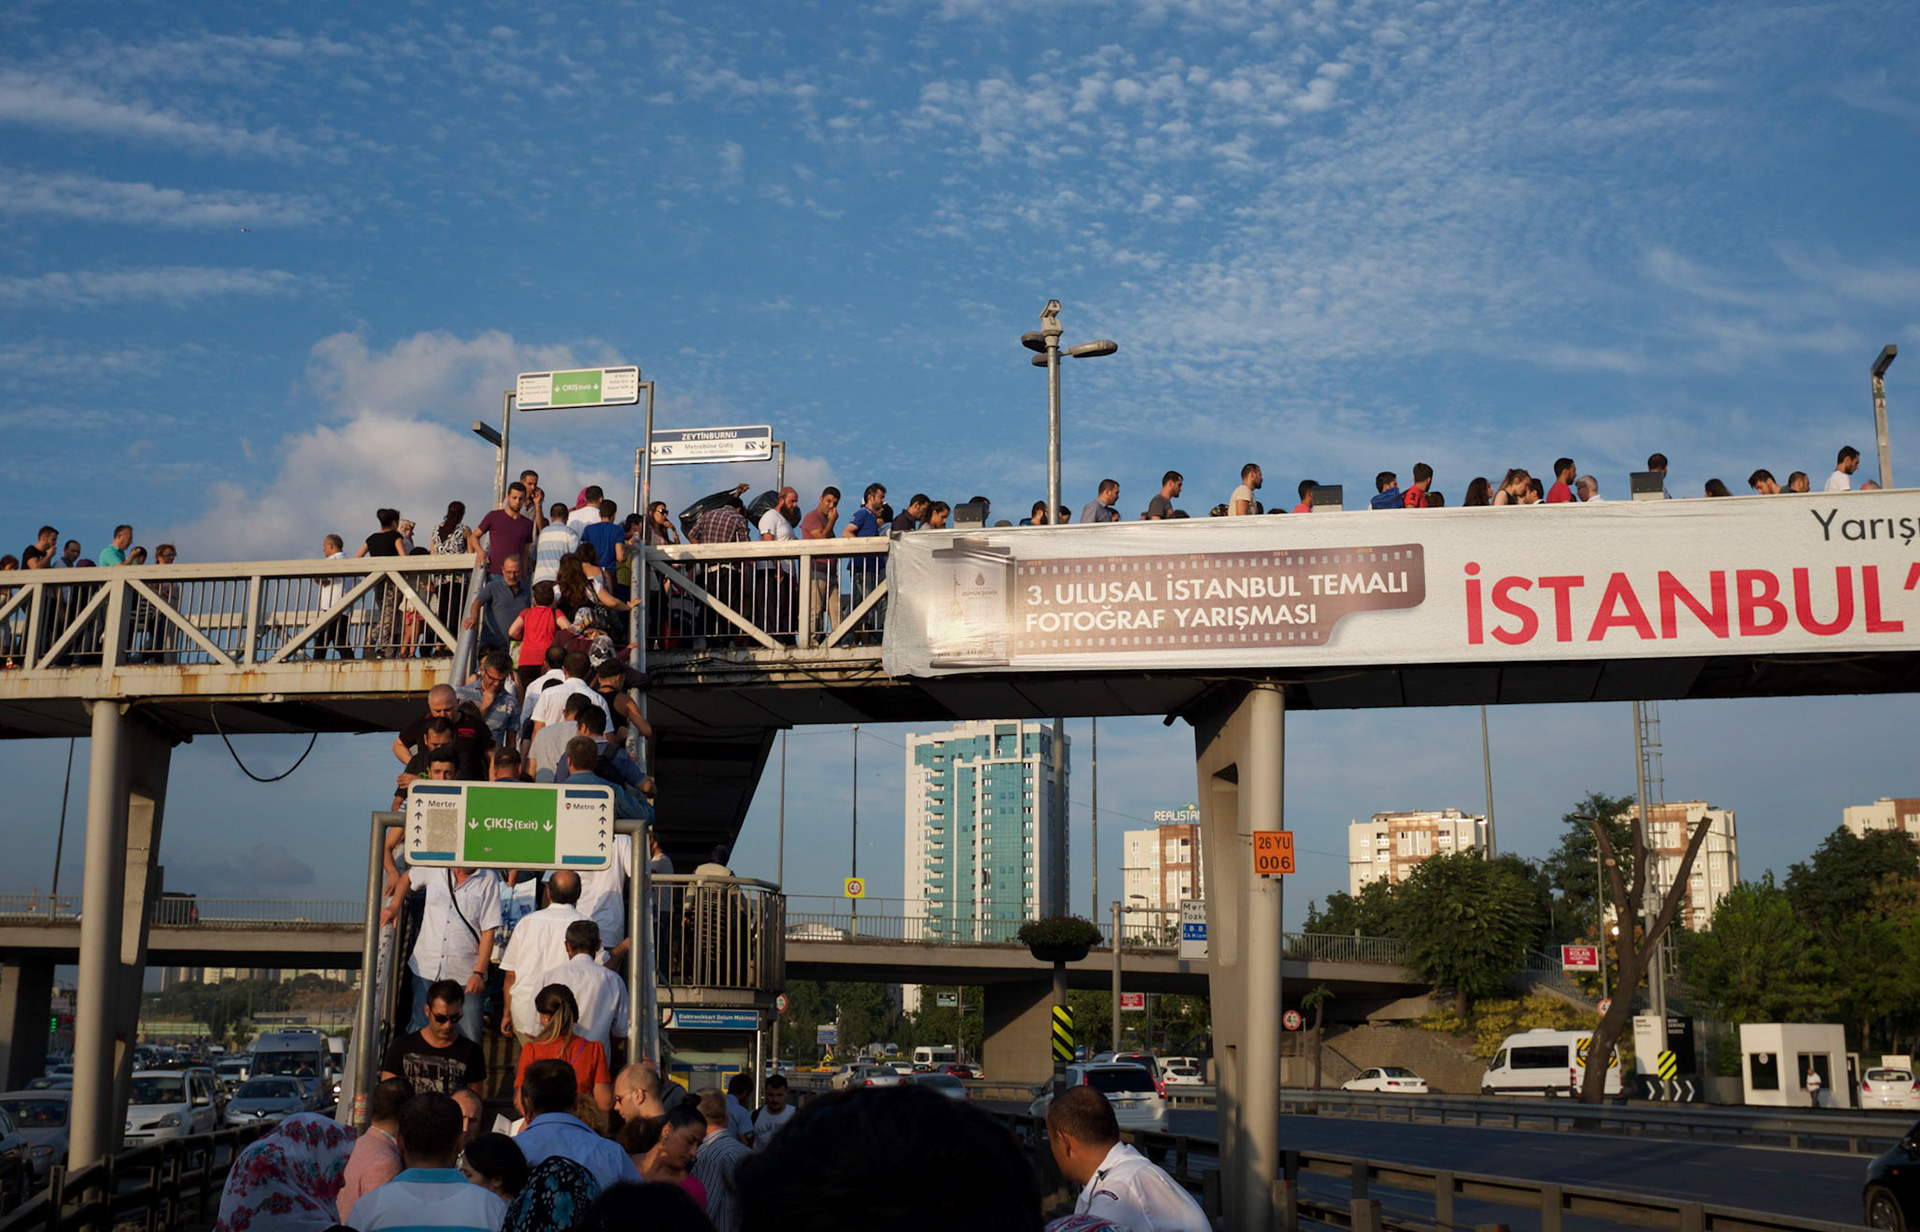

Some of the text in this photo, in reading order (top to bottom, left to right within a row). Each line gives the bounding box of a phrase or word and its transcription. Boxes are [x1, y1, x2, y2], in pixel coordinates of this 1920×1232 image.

[562, 384, 578, 392] ÇIKIŞ
[682, 431, 737, 441] ZEYTİNBURNU
[684, 442, 717, 450] Metrobüse
[1811, 508, 1920, 546] Yarış
[1026, 571, 1408, 606] 3. ULUSAL İSTANBUL TEMALI
[1026, 603, 1317, 632] FOTOĞRAF YARIŞMASI
[428, 799, 456, 808] Merter
[483, 817, 539, 832] ÇIKIŞ (Exit)
[1258, 836, 1290, 849] 26 YU
[1259, 855, 1290, 869] 006
